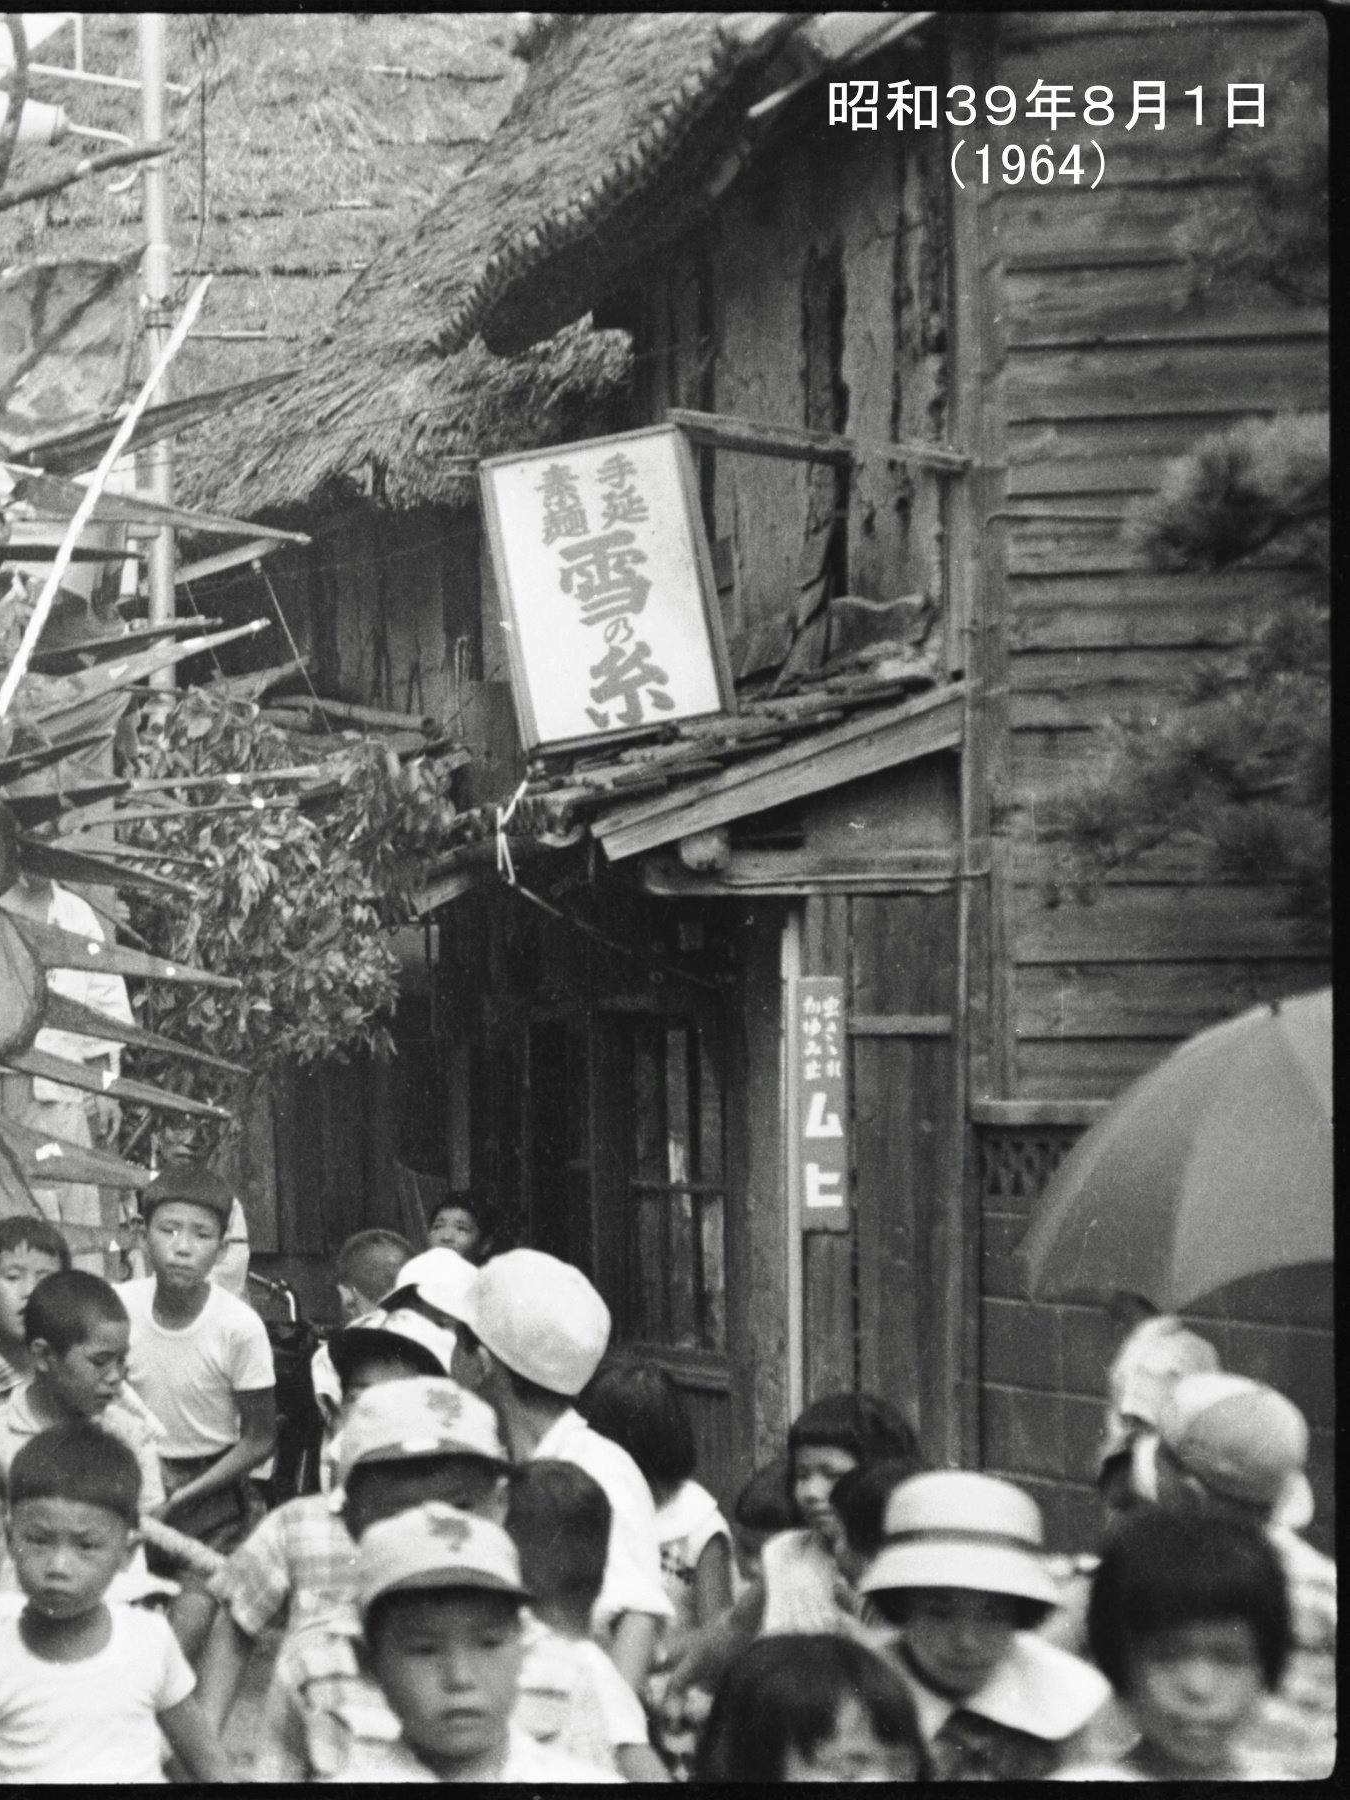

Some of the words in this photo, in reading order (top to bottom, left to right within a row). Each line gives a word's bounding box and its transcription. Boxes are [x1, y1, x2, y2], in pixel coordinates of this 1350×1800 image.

[598, 453, 648, 528] 手延
[559, 530, 675, 728] 雪の糸
[805, 1092, 843, 1208] ムヒ
